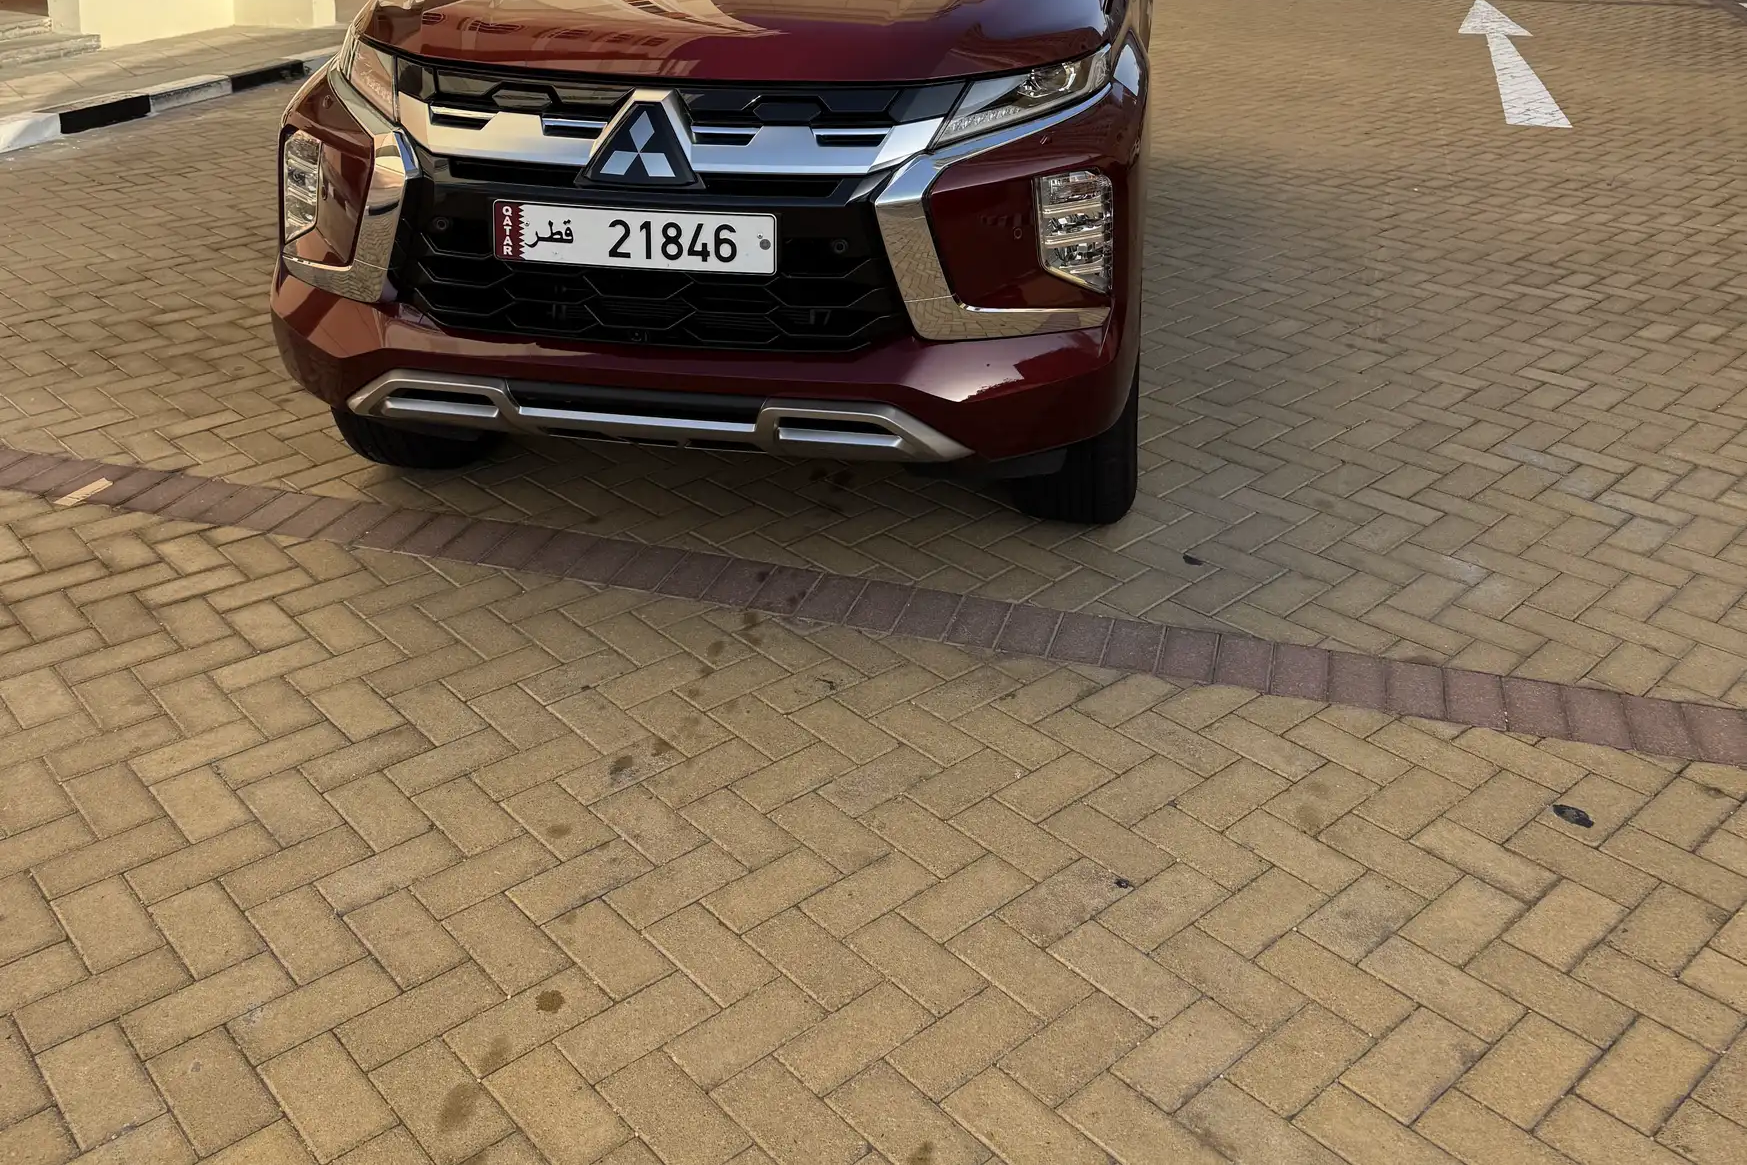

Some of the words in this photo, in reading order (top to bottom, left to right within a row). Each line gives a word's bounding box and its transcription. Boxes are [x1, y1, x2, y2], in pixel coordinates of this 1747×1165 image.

[502, 205, 513, 256] QATAR
[524, 219, 574, 248] قطر
[608, 218, 738, 263] 21846
